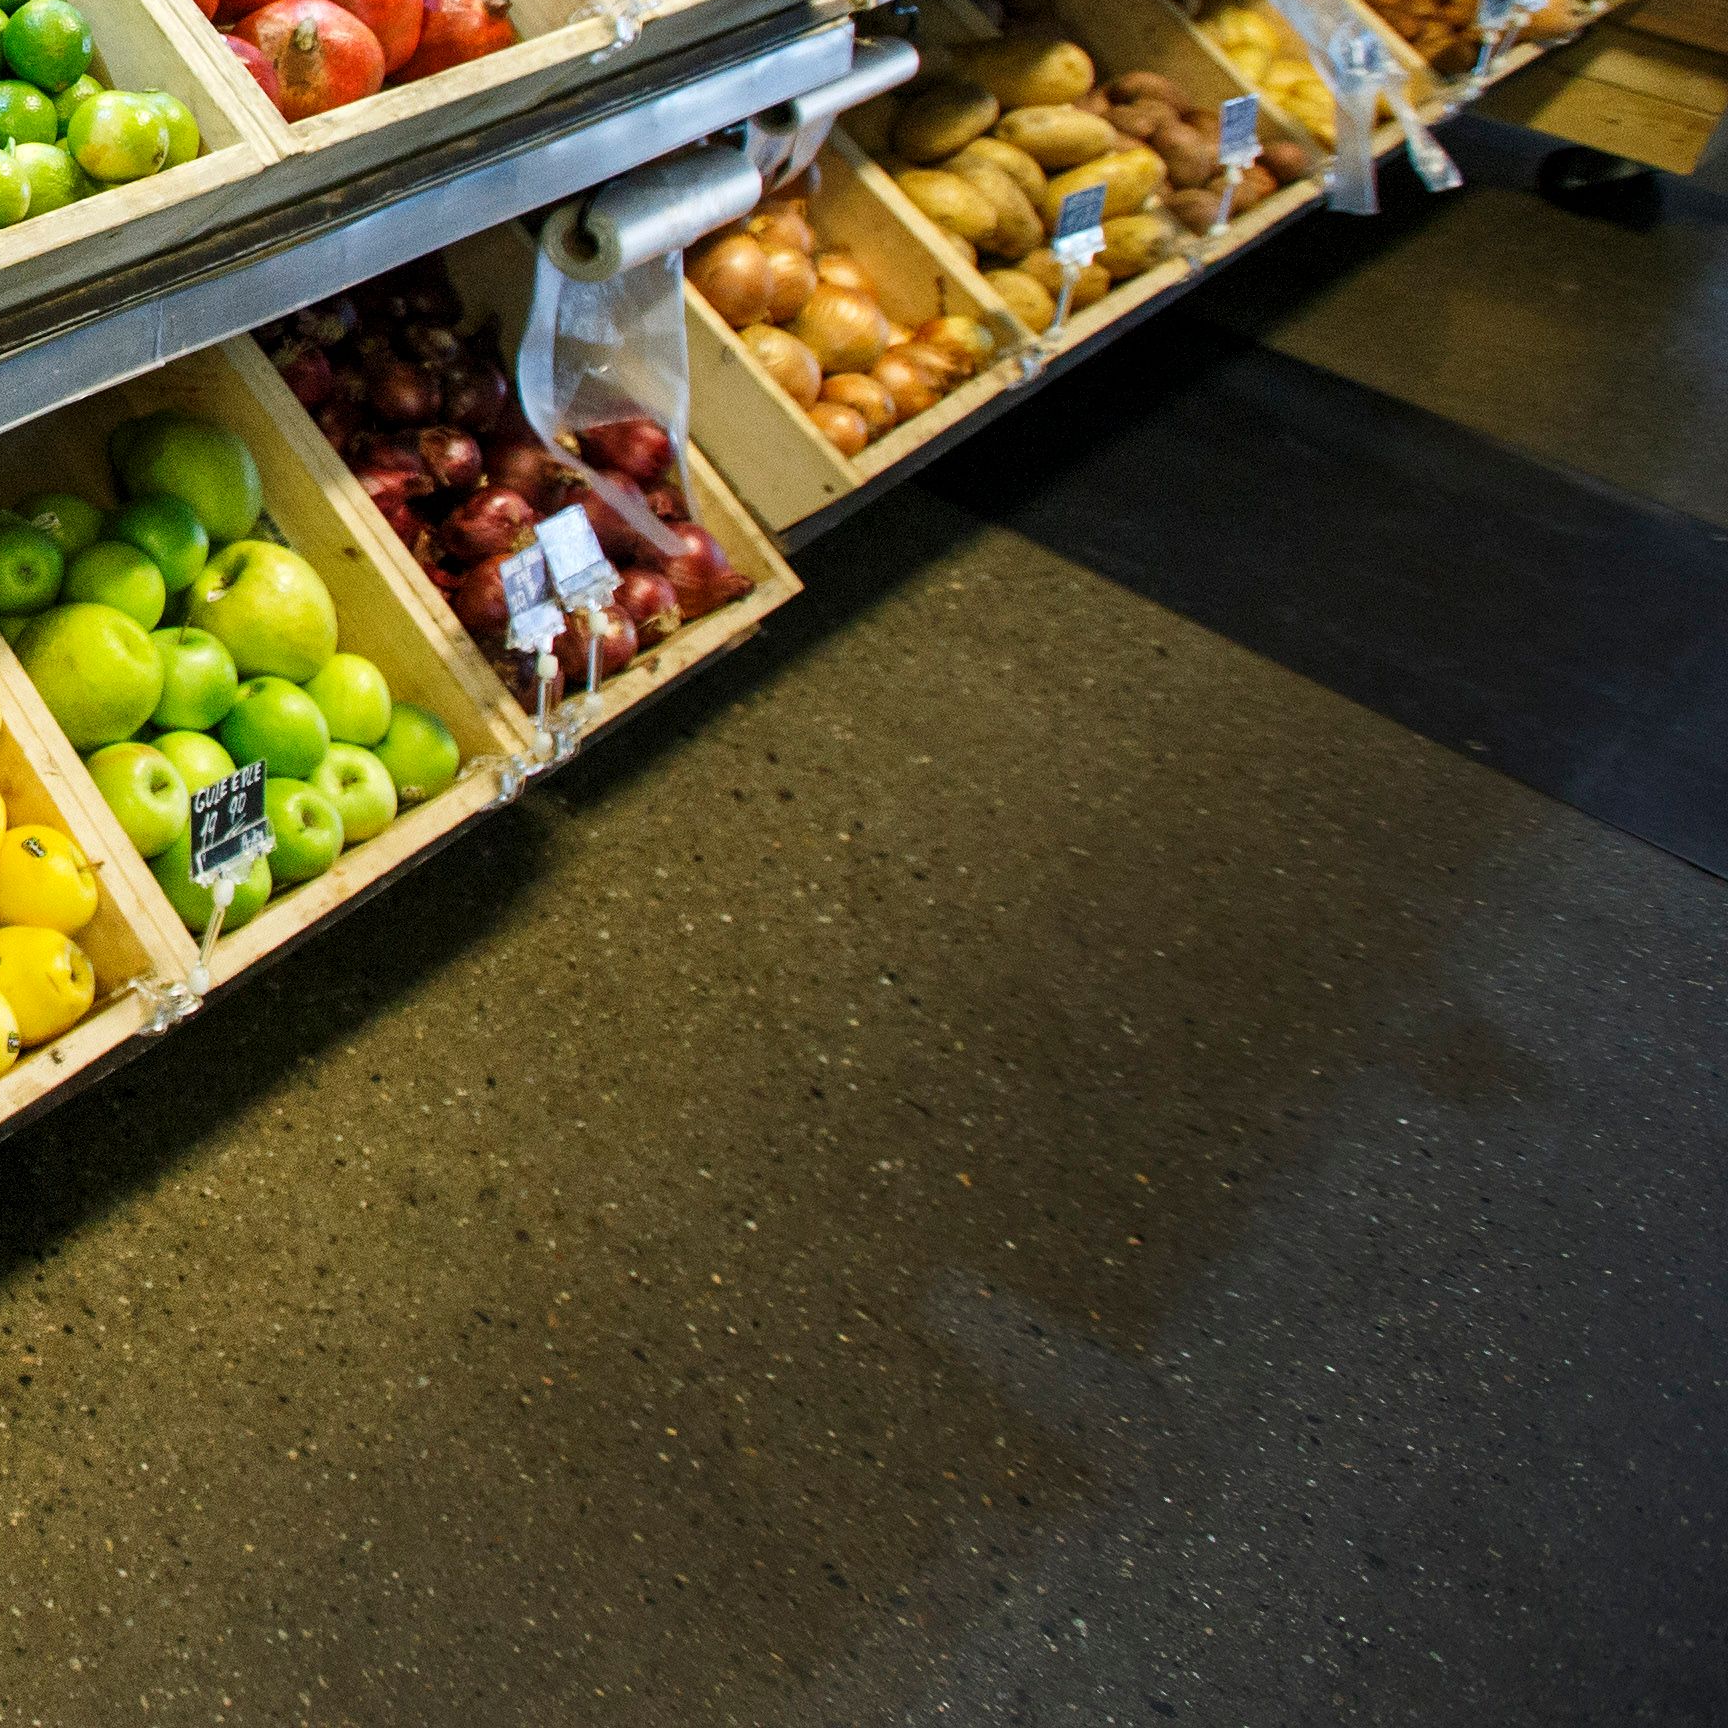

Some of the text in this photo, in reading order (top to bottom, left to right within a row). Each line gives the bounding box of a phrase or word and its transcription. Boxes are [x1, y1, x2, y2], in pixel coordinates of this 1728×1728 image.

[194, 762, 262, 813] GULE EPLE
[229, 791, 247, 825] 90
